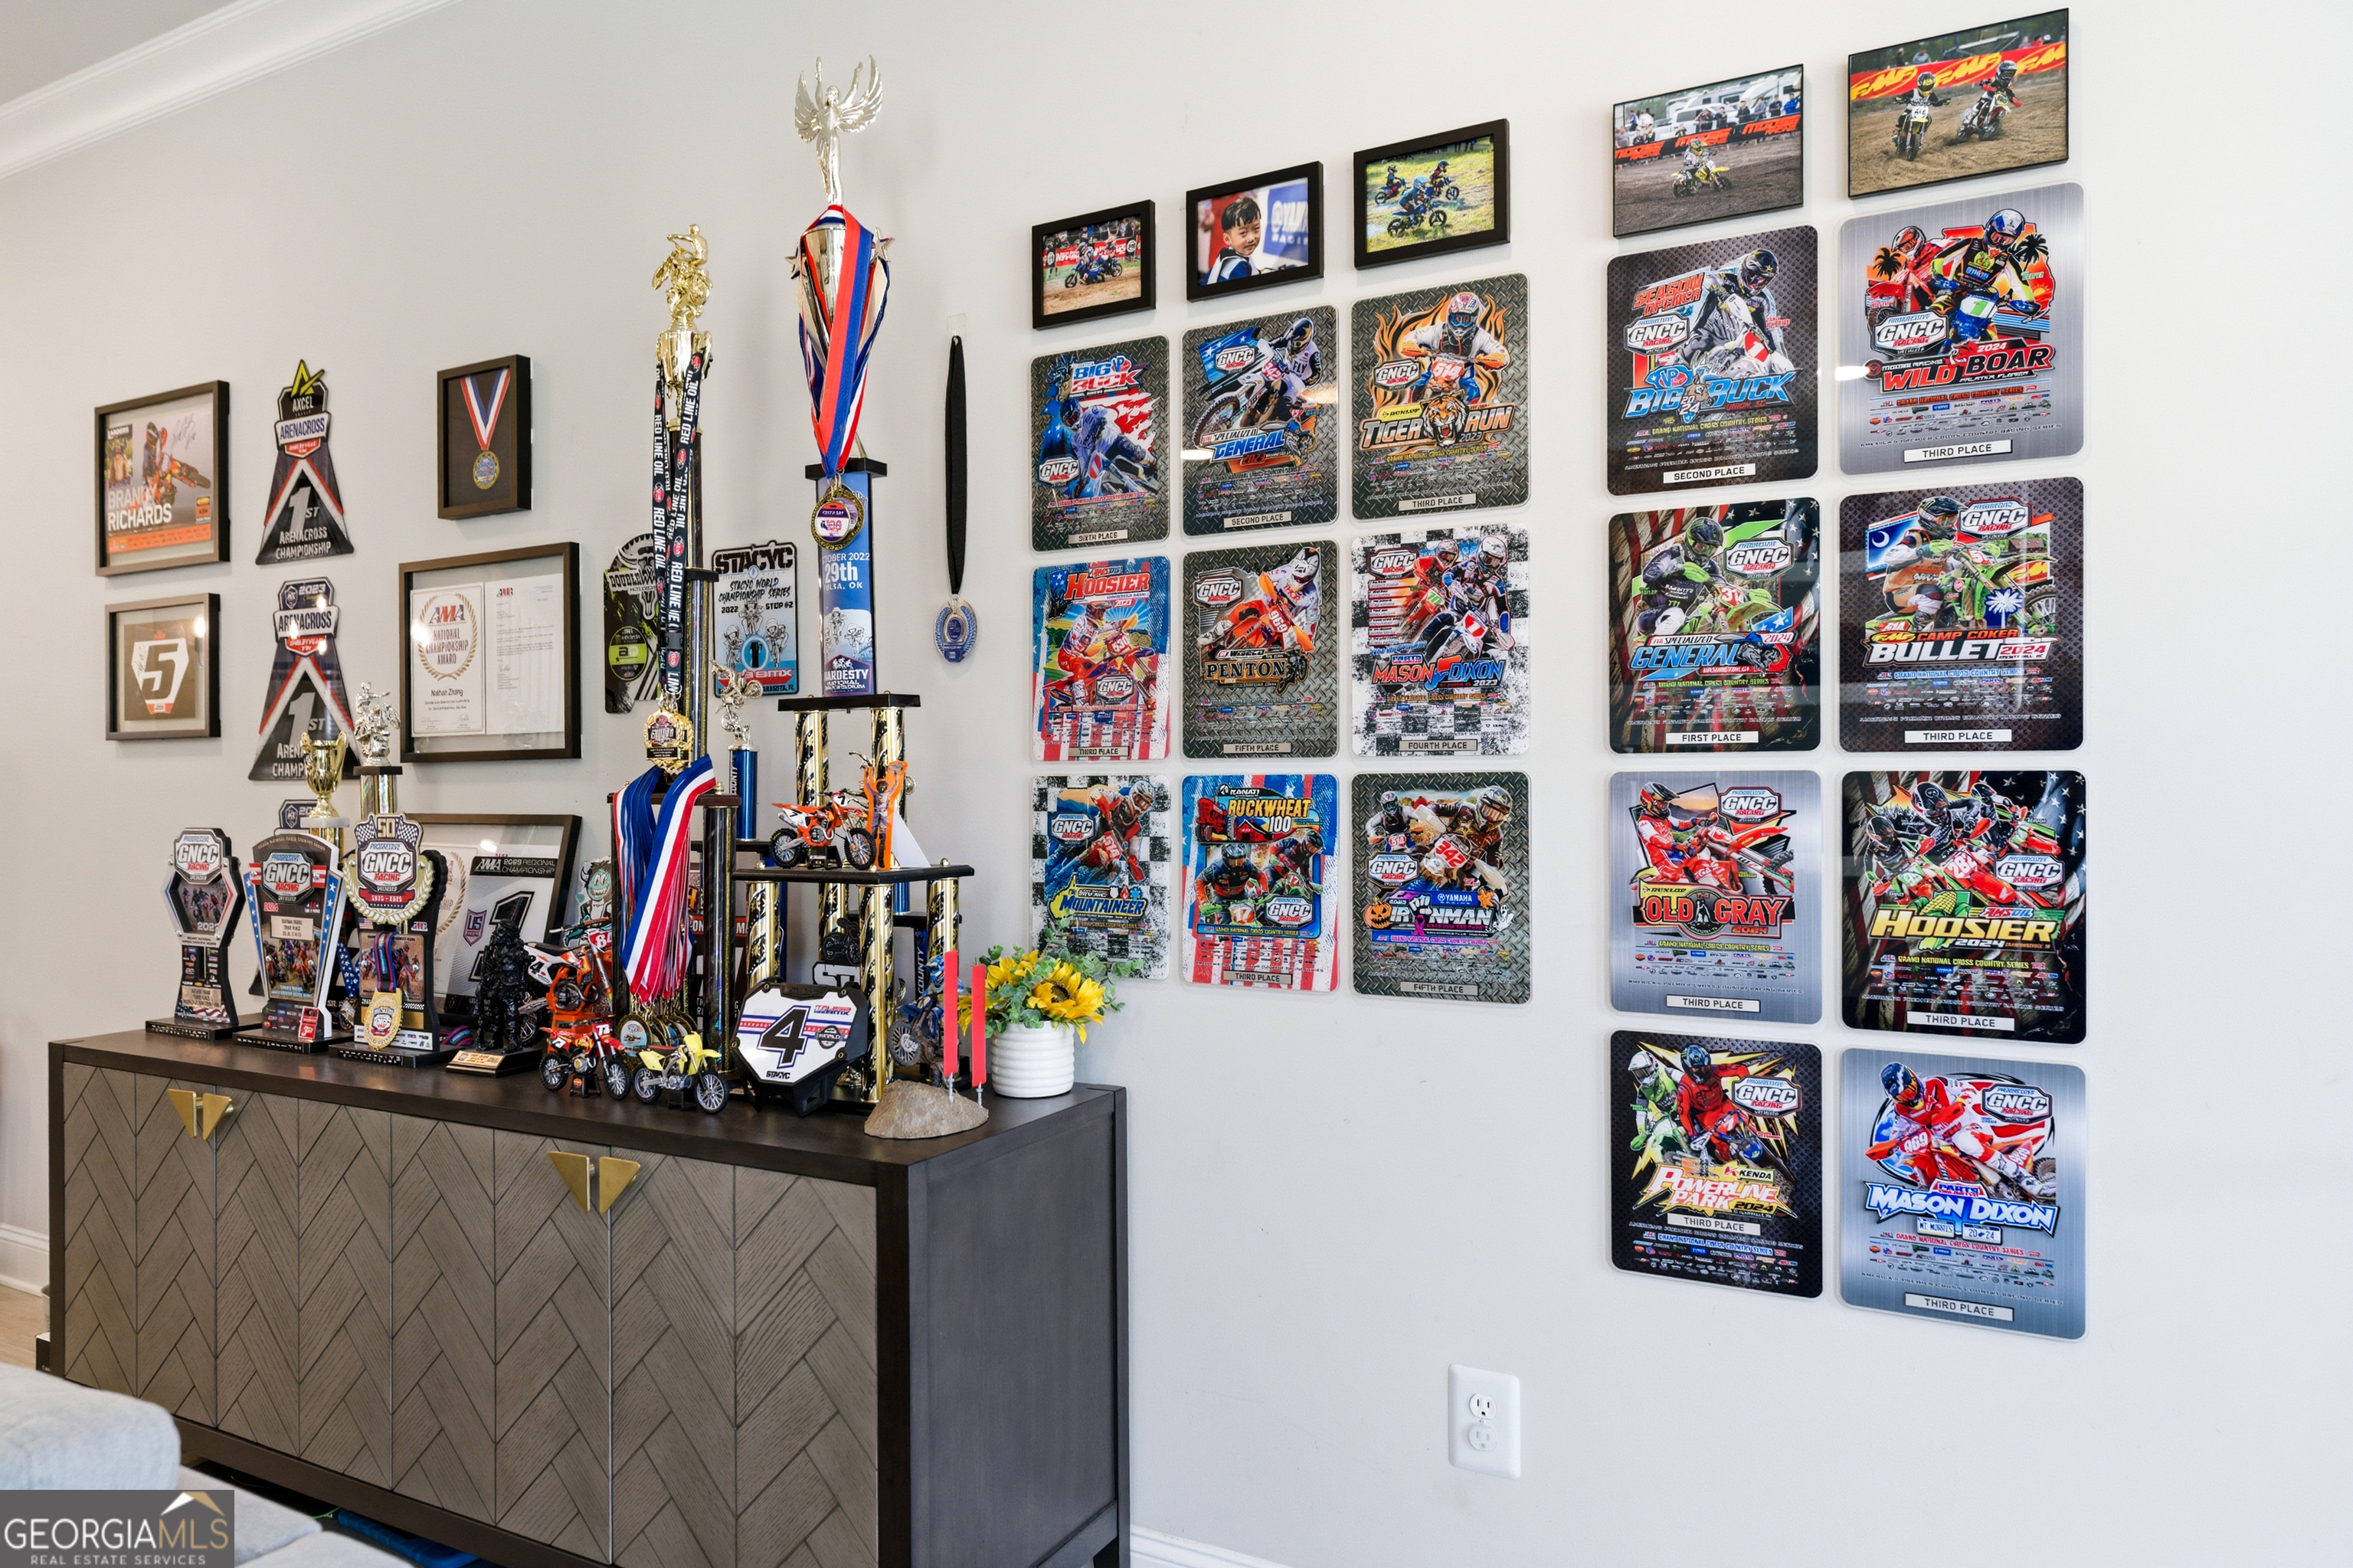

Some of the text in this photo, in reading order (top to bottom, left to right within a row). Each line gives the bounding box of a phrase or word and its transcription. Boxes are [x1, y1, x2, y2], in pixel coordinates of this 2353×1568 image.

[1633, 272, 1704, 309] SEASON
[1970, 300, 1983, 316] 1
[1629, 322, 1687, 343] GNCC
[1878, 319, 1946, 342] GNCC
[1642, 337, 1674, 346] RACING
[1747, 340, 1765, 359] 1
[1977, 342, 2007, 353] 2024
[1216, 348, 1255, 365] GNCC
[1073, 364, 1111, 379] BIG
[1292, 360, 1307, 374] FLY
[1377, 364, 1419, 381] GNCC
[1432, 362, 1461, 380] 514
[1883, 347, 2050, 391] WILD BOAR
[1071, 369, 1139, 392] BUCK
[293, 395, 314, 412] AXCEL
[1625, 372, 1800, 418] BIG BUCK
[680, 380, 699, 444] RED LINE OIL
[1679, 402, 1700, 416] 24
[280, 417, 325, 440] ARENACROSS
[1213, 428, 1257, 442] SPECIALIZED
[1362, 407, 1512, 447] TIGER RUN
[653, 414, 664, 476] RED LINE OIL
[1458, 431, 1483, 443] 2023
[1214, 433, 1286, 460] GENERAL
[1923, 444, 1991, 458] THIRD PLACE
[1042, 460, 1078, 477] GNCC
[1674, 466, 1745, 481] SECOND PLACE
[1412, 496, 1463, 508] THIRD PLACE
[108, 502, 172, 532] RICHARDS
[1232, 512, 1284, 525] SECOND PLACE
[1965, 509, 2027, 526] GNCC
[280, 527, 328, 545] ARENACROSS
[1098, 532, 1118, 540] PLACE
[1977, 523, 2013, 532] RACING
[653, 507, 666, 569] RED LINE OIL
[276, 542, 331, 559] CHAMPIONSHIP
[849, 552, 870, 561] 2022
[1729, 548, 1789, 565] GNCC
[715, 546, 794, 574] STACYC
[1371, 553, 1415, 570] GNCC
[824, 562, 858, 584] 29th
[299, 584, 326, 595] 2023
[669, 561, 683, 609] RED LINE
[756, 578, 779, 588] WORLD
[1064, 572, 1150, 601] HOOSIER
[1199, 582, 1241, 597] GNCC
[718, 586, 791, 604] CHAMPIONSHIP SERIES
[1284, 584, 1301, 603] THOR
[278, 611, 332, 632] ARENACROSS
[429, 604, 465, 624] AMA
[434, 628, 460, 640] NATIONAL
[1664, 633, 1792, 644] SPECIALIZED 2024
[1916, 629, 2018, 642] CAMP COKER
[426, 640, 469, 654] CHAMPIONSHIP
[1631, 643, 1740, 668] GENERAL
[1869, 639, 2004, 663] BULLET
[2000, 645, 2047, 655] 2024
[437, 653, 457, 665] AWARD
[1206, 660, 1288, 679] PENTON
[1372, 660, 1506, 683] MASON DIXON
[1098, 679, 1133, 693] GNCC
[1682, 733, 1742, 742] FIRST PLACE
[1959, 732, 1993, 740] PLACE
[1235, 743, 1279, 752] FIFTH PLACE
[1228, 799, 1313, 817] BUCKWHEAT
[1723, 796, 1778, 811] GNCC
[377, 818, 395, 837] 50
[1052, 820, 1093, 833] GNCC
[1268, 817, 1292, 833] 100
[178, 844, 218, 863] GNCC
[1434, 839, 1468, 869] 342
[364, 852, 411, 873] GNCC
[475, 859, 502, 871] AMA
[1370, 861, 1417, 875] GNCC
[2000, 863, 2060, 878] GNCC
[266, 863, 309, 883] GNCC
[374, 873, 401, 882] RACING
[2013, 876, 2047, 884] RACING
[1059, 895, 1146, 915] MOUNTAINEER
[1445, 894, 1472, 902] YAMAHA
[1268, 903, 1312, 918] GNCC
[1647, 896, 1784, 925] OLD GRAY
[1982, 907, 2034, 918] AMSOIL
[1731, 926, 1769, 935] 2024
[1870, 909, 2058, 942] HOOSIER
[1954, 938, 2006, 948] 2024
[1921, 956, 1952, 965] NATIONAL
[1235, 972, 1280, 982] THIRD PLACE
[1414, 984, 1464, 994] FIFTH PLACE
[1683, 998, 1743, 1010] THIRD PLACE
[1926, 1014, 1995, 1028] THIRD PLACE
[757, 1005, 811, 1069] 4
[767, 1071, 790, 1079] STACYC
[1737, 1085, 1795, 1104] GNCC
[1987, 1092, 2047, 1111] GNCC
[1903, 1131, 1929, 1152] 969
[1739, 1170, 1772, 1180] KENDA
[1646, 1166, 1779, 1203] POWERLINE
[1669, 1190, 1734, 1210] PARK
[1734, 1201, 1774, 1212] 2024
[1870, 1187, 2055, 1227] MASON DIXON
[1684, 1216, 1745, 1231] THIRD PLACE
[1968, 1229, 1995, 1239] 20 24
[1919, 1236, 1947, 1246] NATIONAL
[1972, 1243, 2000, 1252] COUNTRY
[1924, 1298, 1995, 1316] THIRD PLACE
